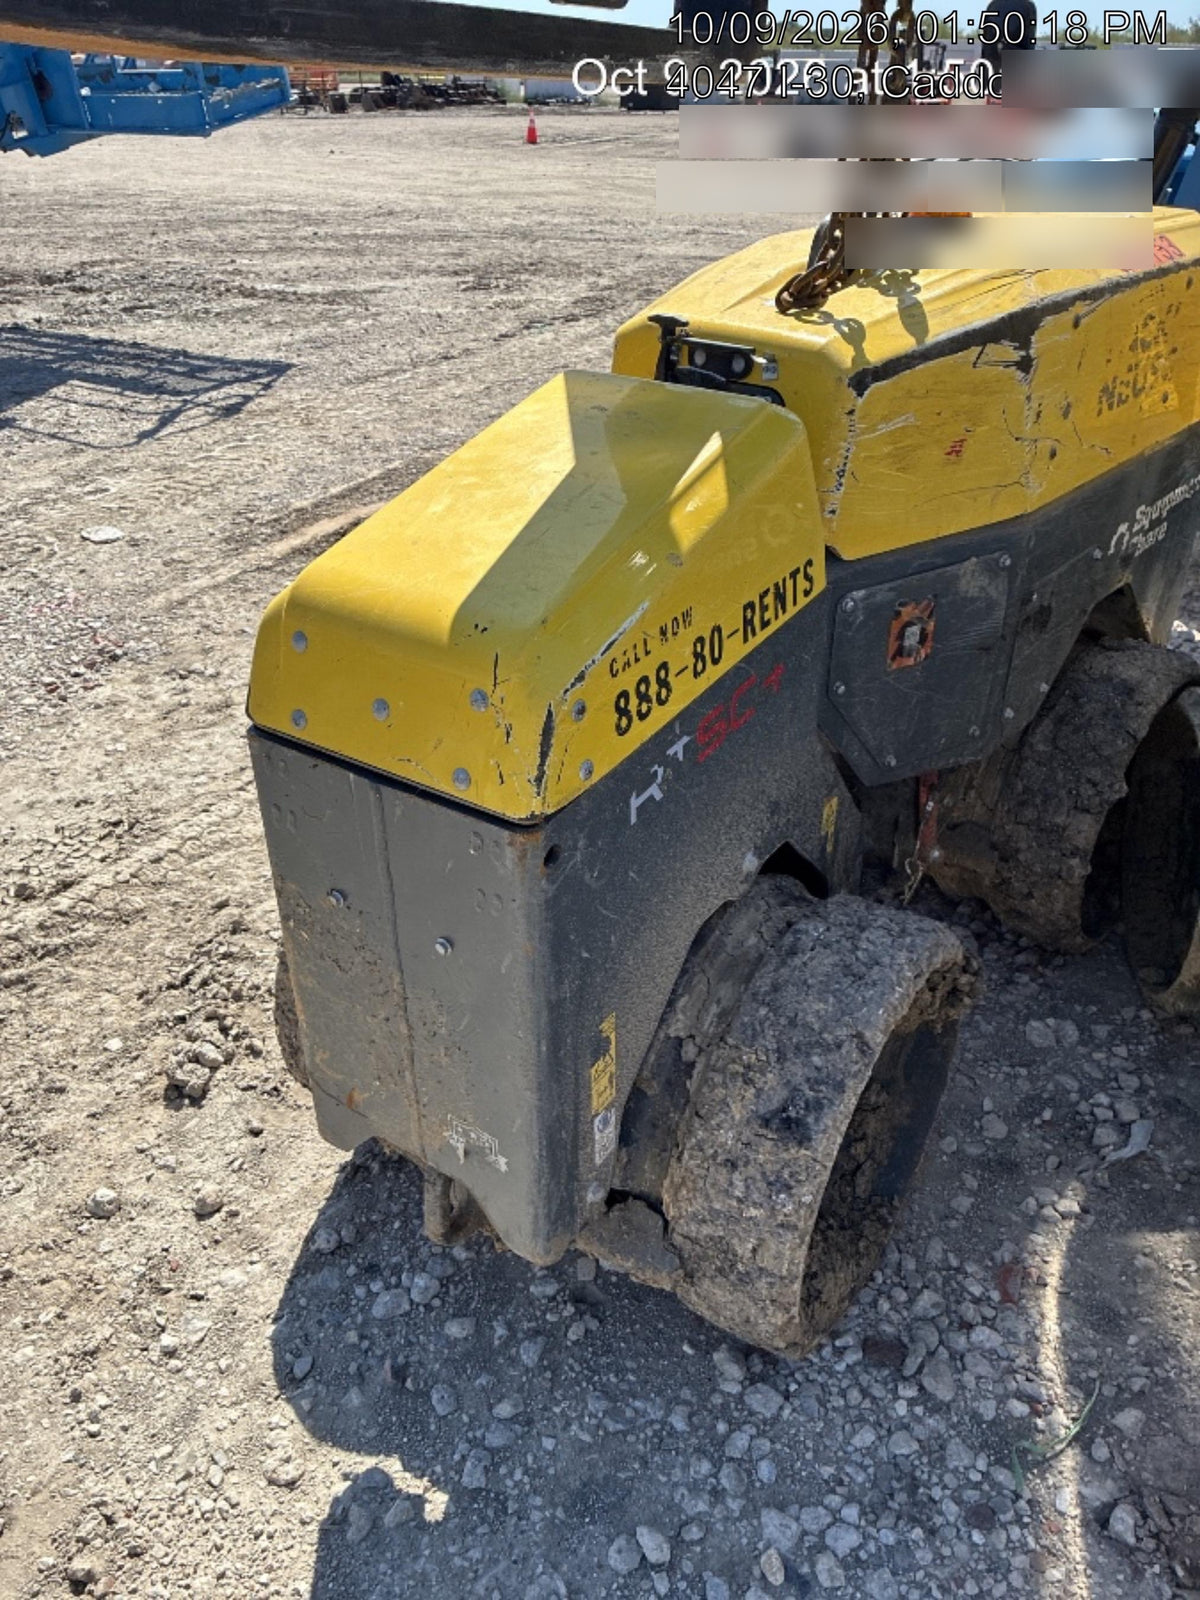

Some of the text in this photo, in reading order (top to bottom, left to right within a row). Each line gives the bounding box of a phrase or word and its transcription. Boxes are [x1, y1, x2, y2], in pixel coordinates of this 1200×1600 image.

[609, 605, 693, 679] CALL NOW
[614, 558, 814, 737] 888-80-RENTS
